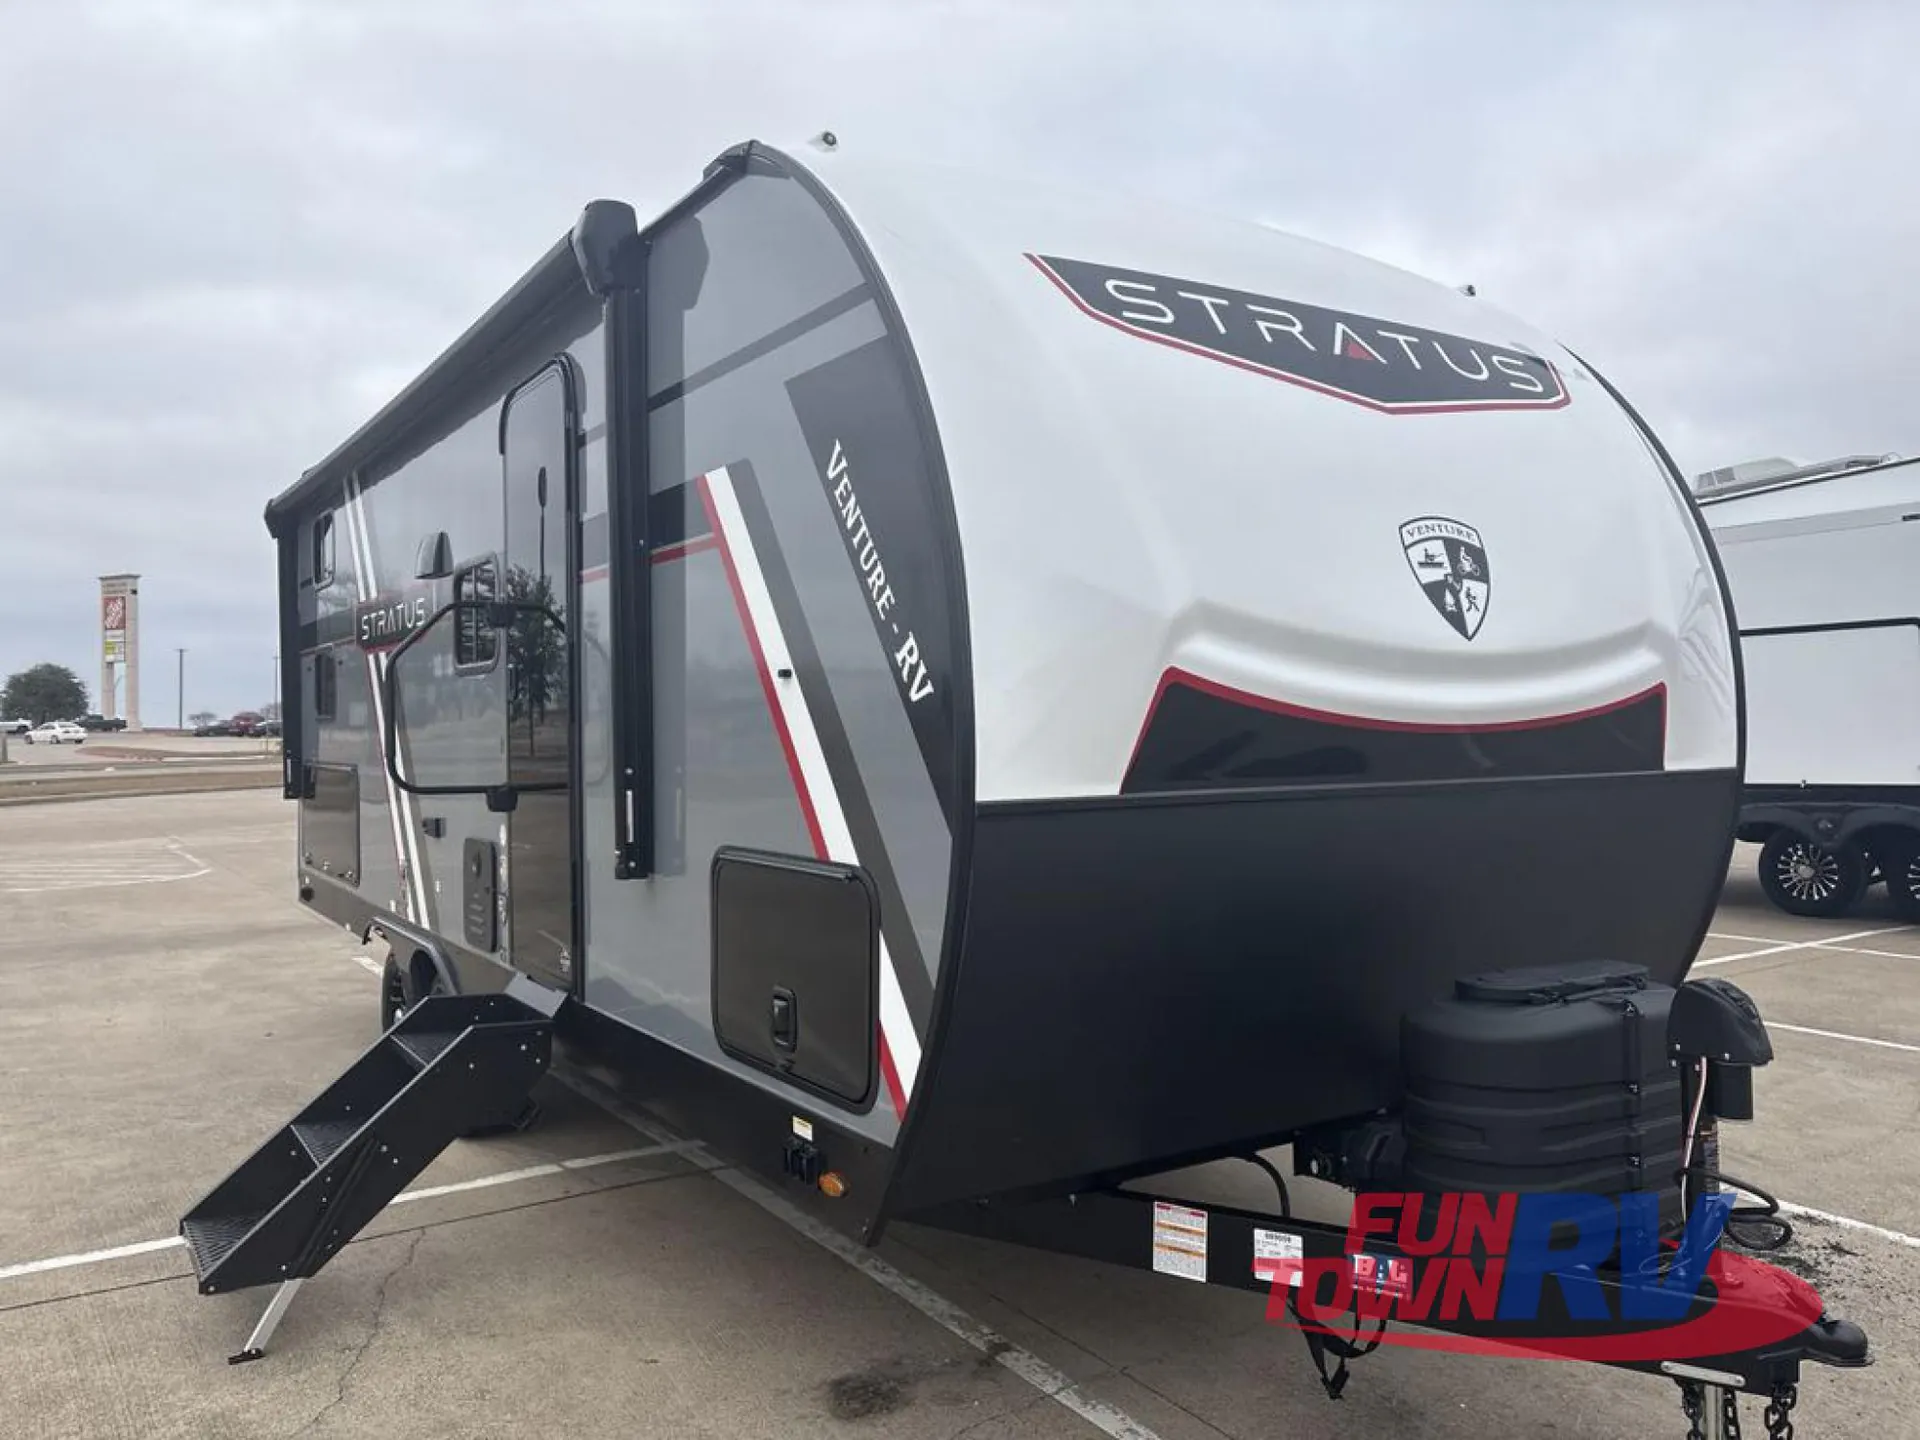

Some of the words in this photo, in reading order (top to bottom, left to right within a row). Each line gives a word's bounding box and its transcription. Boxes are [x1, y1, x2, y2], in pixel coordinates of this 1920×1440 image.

[1104, 278, 1544, 393] STRATUS
[826, 438, 896, 621] VENTURE
[895, 630, 935, 703] RV
[1405, 522, 1477, 543] VENTURE
[361, 597, 426, 640] STRATUS
